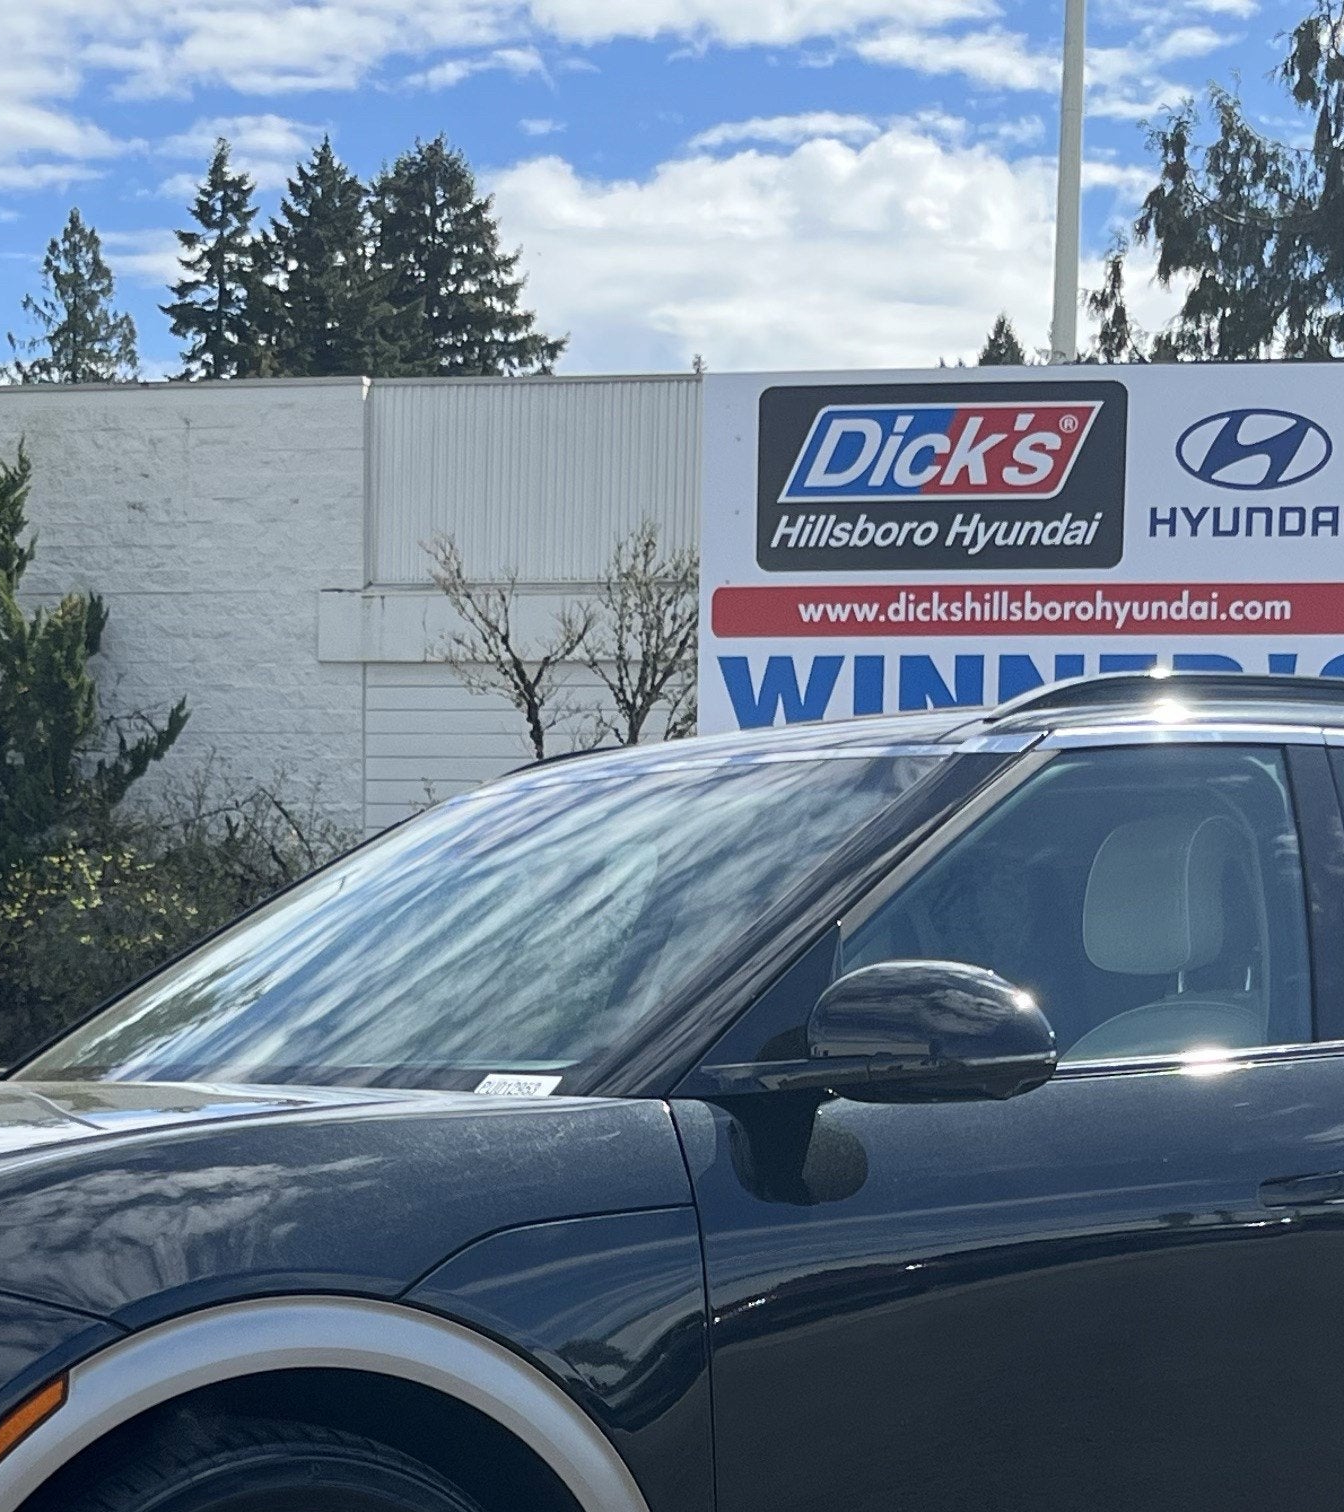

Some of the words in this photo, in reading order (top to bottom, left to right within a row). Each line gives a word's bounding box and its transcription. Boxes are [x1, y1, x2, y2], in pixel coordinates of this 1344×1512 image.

[804, 414, 1062, 489] Dick's
[770, 513, 939, 550] Hillsboro
[944, 512, 1103, 554] Hyundai
[798, 590, 1292, 629] www.dickshillsborohyundai.com
